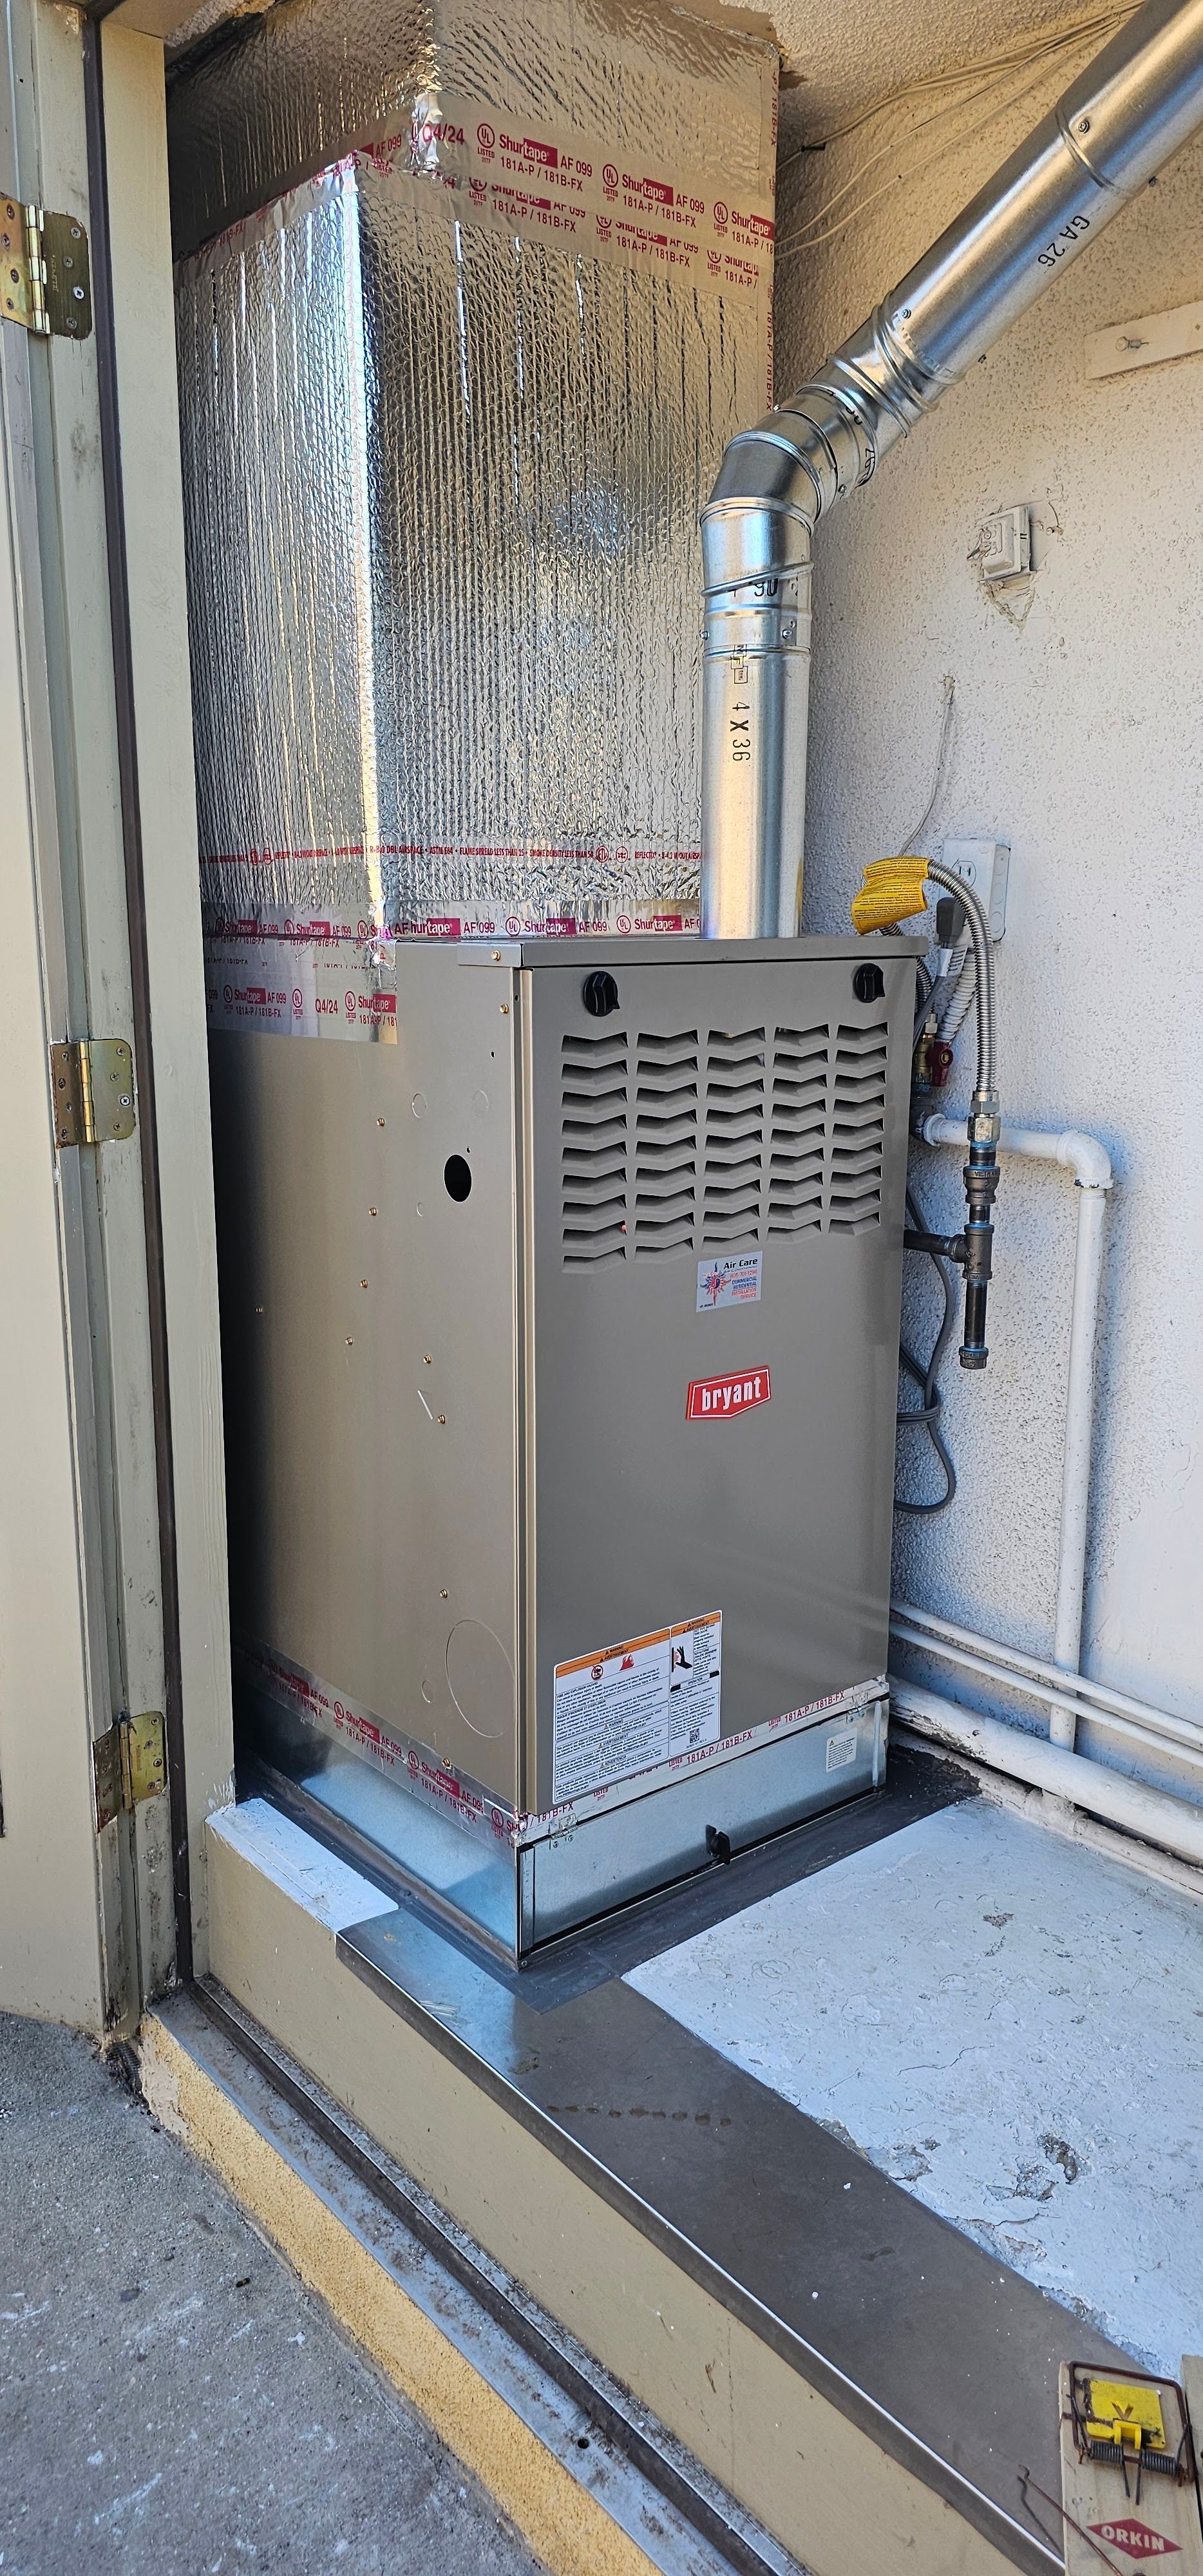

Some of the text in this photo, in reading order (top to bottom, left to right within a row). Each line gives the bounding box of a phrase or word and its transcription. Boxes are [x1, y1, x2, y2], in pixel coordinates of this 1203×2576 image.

[376, 134, 402, 158] AF 099
[477, 147, 495, 159] LISTED
[499, 133, 592, 178] Shurtape AF 099
[500, 156, 535, 176] 181A-P
[544, 170, 583, 192] 181B-FX
[469, 190, 487, 202] LISTED
[603, 186, 618, 198] LISTED
[621, 173, 705, 214] Shurtape AF 099
[493, 199, 527, 218] 181A-P
[536, 211, 576, 233] 181B-FX
[623, 194, 654, 213] 181A-P
[661, 207, 696, 228] 181B-FX
[714, 223, 728, 233] LISTED
[731, 211, 770, 236] Shurtape
[596, 227, 612, 238] LISTED
[732, 231, 759, 248] 181A-P
[1037, 215, 1090, 267] GA 26
[616, 235, 647, 253] 181A-P
[656, 247, 690, 268] 181B-FX
[707, 262, 721, 272] LISTED
[725, 270, 752, 287] 181A-P
[732, 701, 750, 712] 4
[730, 719, 749, 732] X
[732, 739, 751, 762] 36
[463, 922, 477, 934] AF
[478, 922, 495, 933] 099
[578, 921, 590, 933] AF
[592, 921, 607, 932] 099
[634, 918, 674, 931] Shurtape
[684, 918, 695, 929] AF
[267, 992, 276, 1003] AF
[276, 992, 287, 1004] 099
[315, 998, 339, 1014] Q4/24
[358, 995, 390, 1013] Shurtape
[723, 1258, 758, 1270] Air Care
[732, 1276, 757, 1285] COMMERCIAL
[701, 1376, 761, 1412] bryant
[768, 1716, 781, 1727] LISTED
[784, 1706, 810, 1723] 181A-P
[346, 1710, 403, 1757] Shurtape AF 099
[346, 1726, 365, 1745] 181A-P
[371, 1743, 395, 1766] 181B-FX
[687, 1746, 714, 1765] 181A-P
[721, 1730, 753, 1750] 181B-FX
[668, 1757, 683, 1767] LISTED
[421, 1777, 443, 1798] 181A-P
[450, 1797, 477, 1823] 181B-FX
[461, 1790, 471, 1803] AF
[592, 1787, 609, 1797] LISTED
[536, 1802, 574, 1824] 181B-FX
[1100, 2524, 1166, 2552] ORKIN
